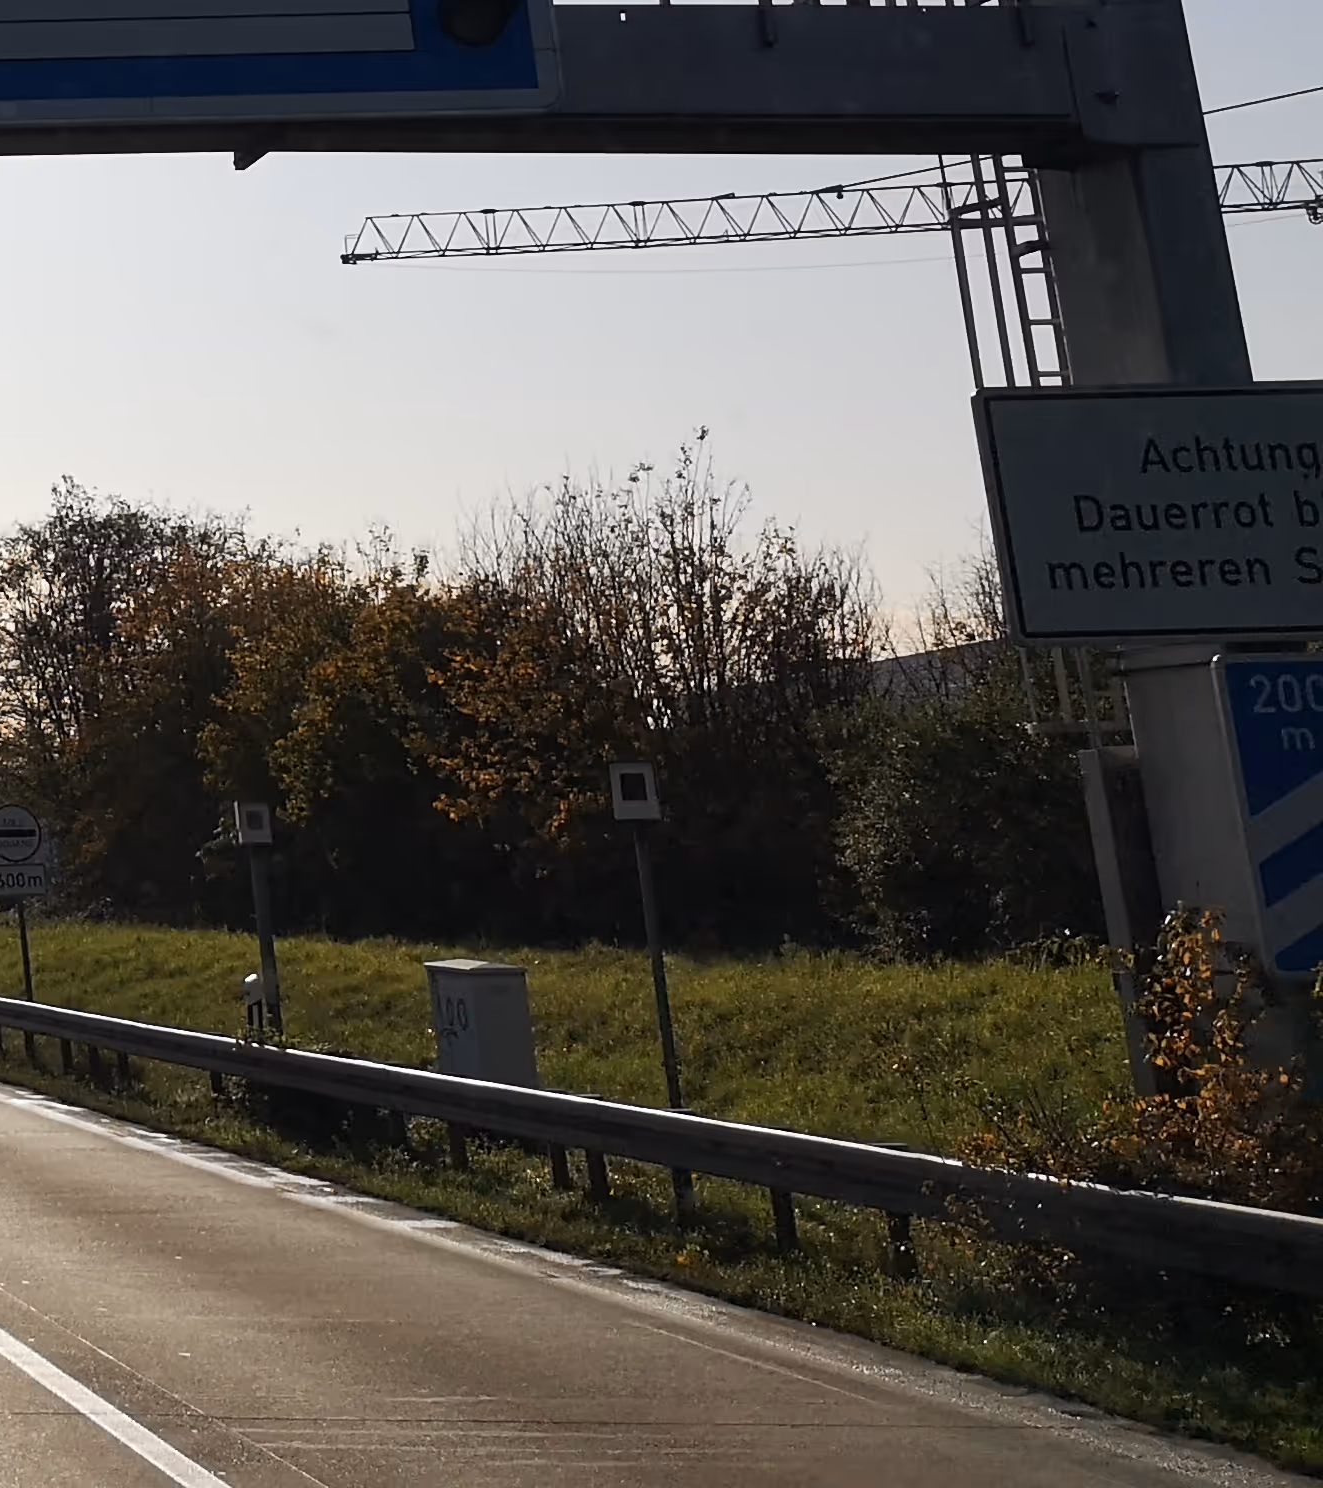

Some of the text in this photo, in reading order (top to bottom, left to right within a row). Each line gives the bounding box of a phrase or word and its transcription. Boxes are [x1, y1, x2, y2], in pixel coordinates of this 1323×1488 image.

[1140, 436, 1321, 479] Achtung
[1072, 493, 1274, 532] Dauerrot
[1047, 552, 1272, 591] mehreren
[1281, 726, 1316, 751] m
